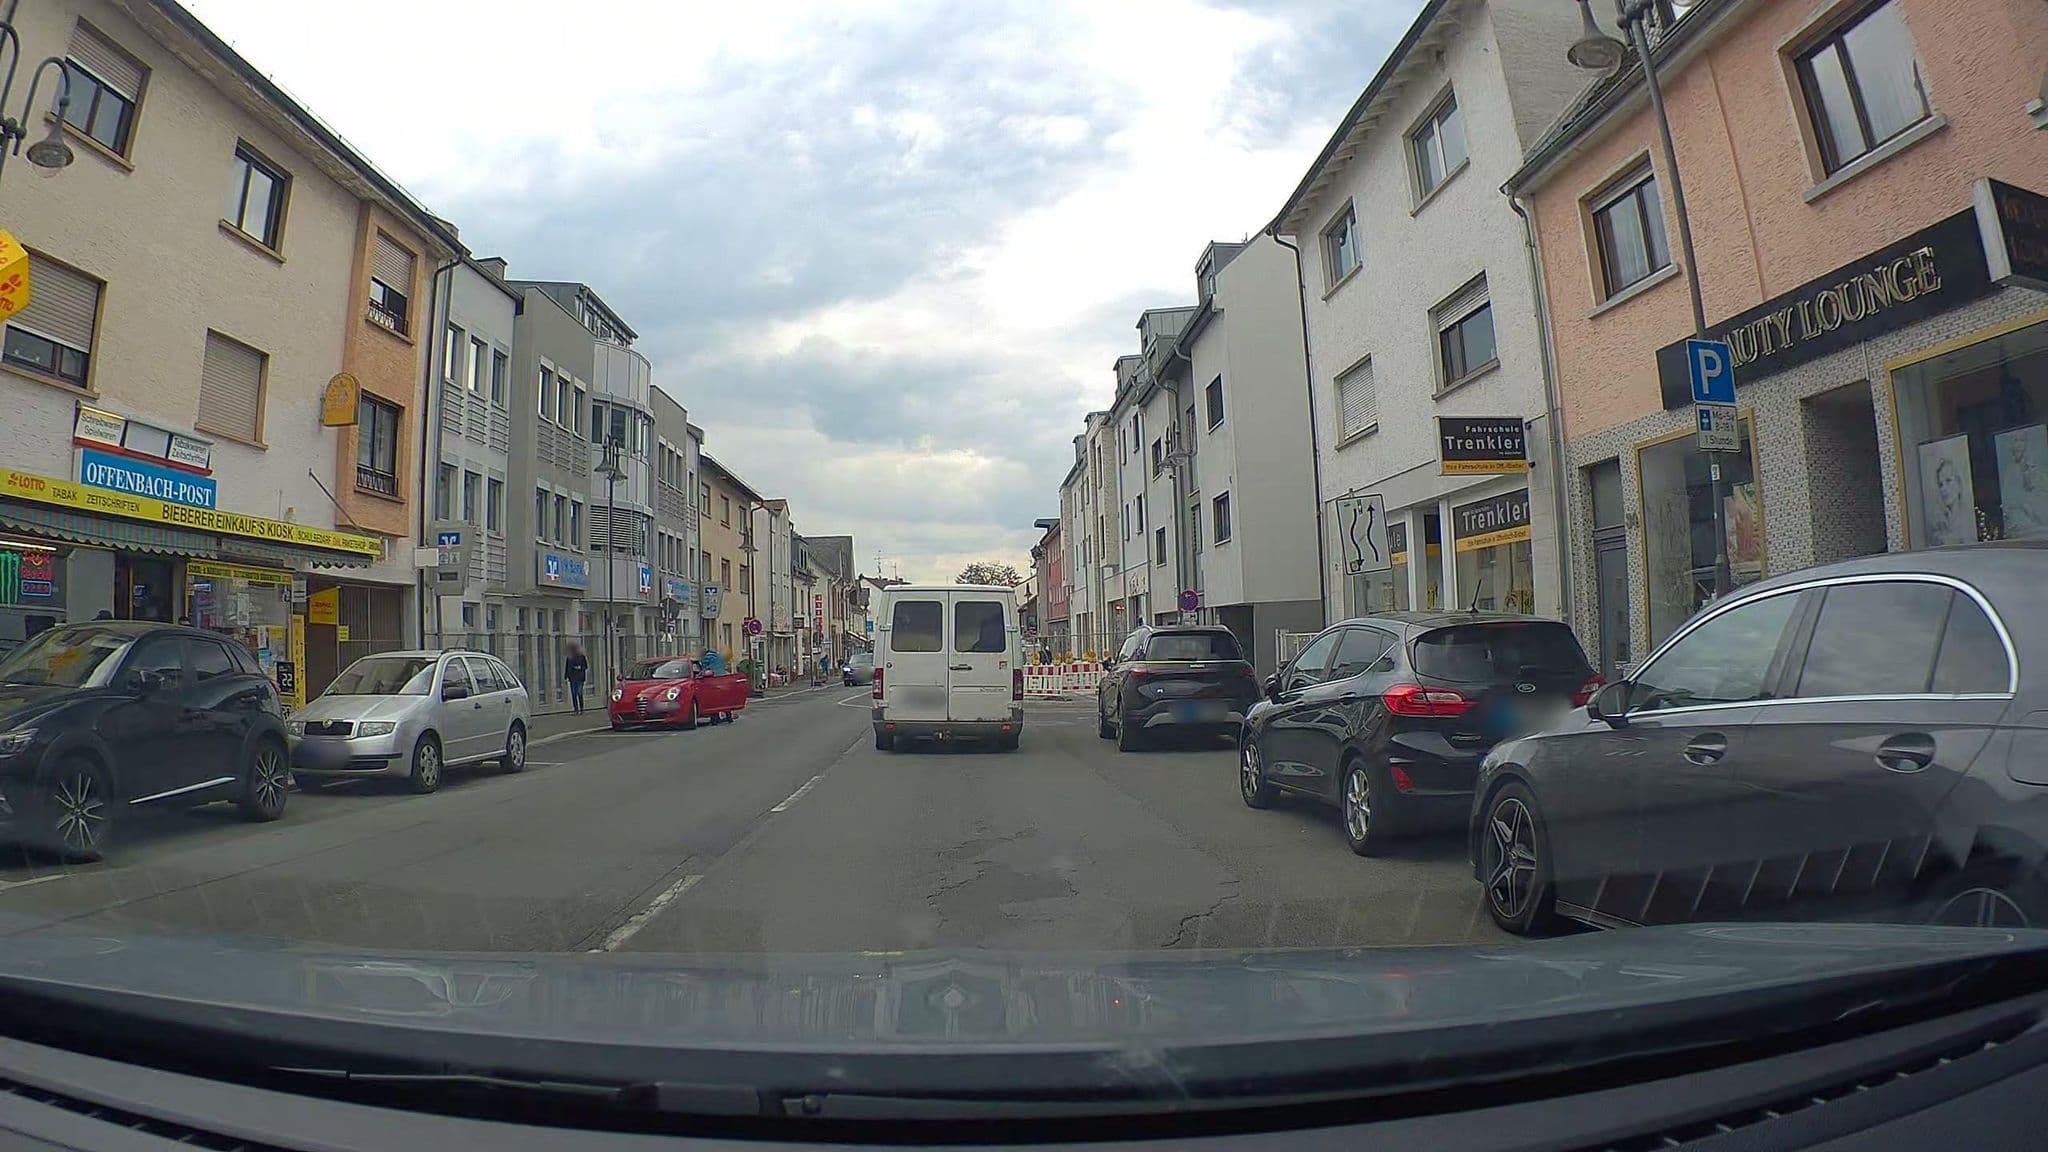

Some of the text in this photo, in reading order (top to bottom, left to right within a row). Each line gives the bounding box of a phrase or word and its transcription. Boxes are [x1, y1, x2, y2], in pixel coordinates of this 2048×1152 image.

[1797, 246, 1941, 341] LOUNGE
[1698, 349, 1722, 394] P
[1445, 436, 1520, 450] Trenkler
[1465, 425, 1520, 433] Fahrschule
[19, 475, 46, 492] LOTTO
[87, 462, 212, 507] OFFENBACH-POST
[52, 487, 141, 513] TABAK ZEITSCHRIFTEN
[162, 504, 215, 528] BIEBERER
[267, 522, 294, 540] KIOSK
[1463, 501, 1528, 532] Trenkler
